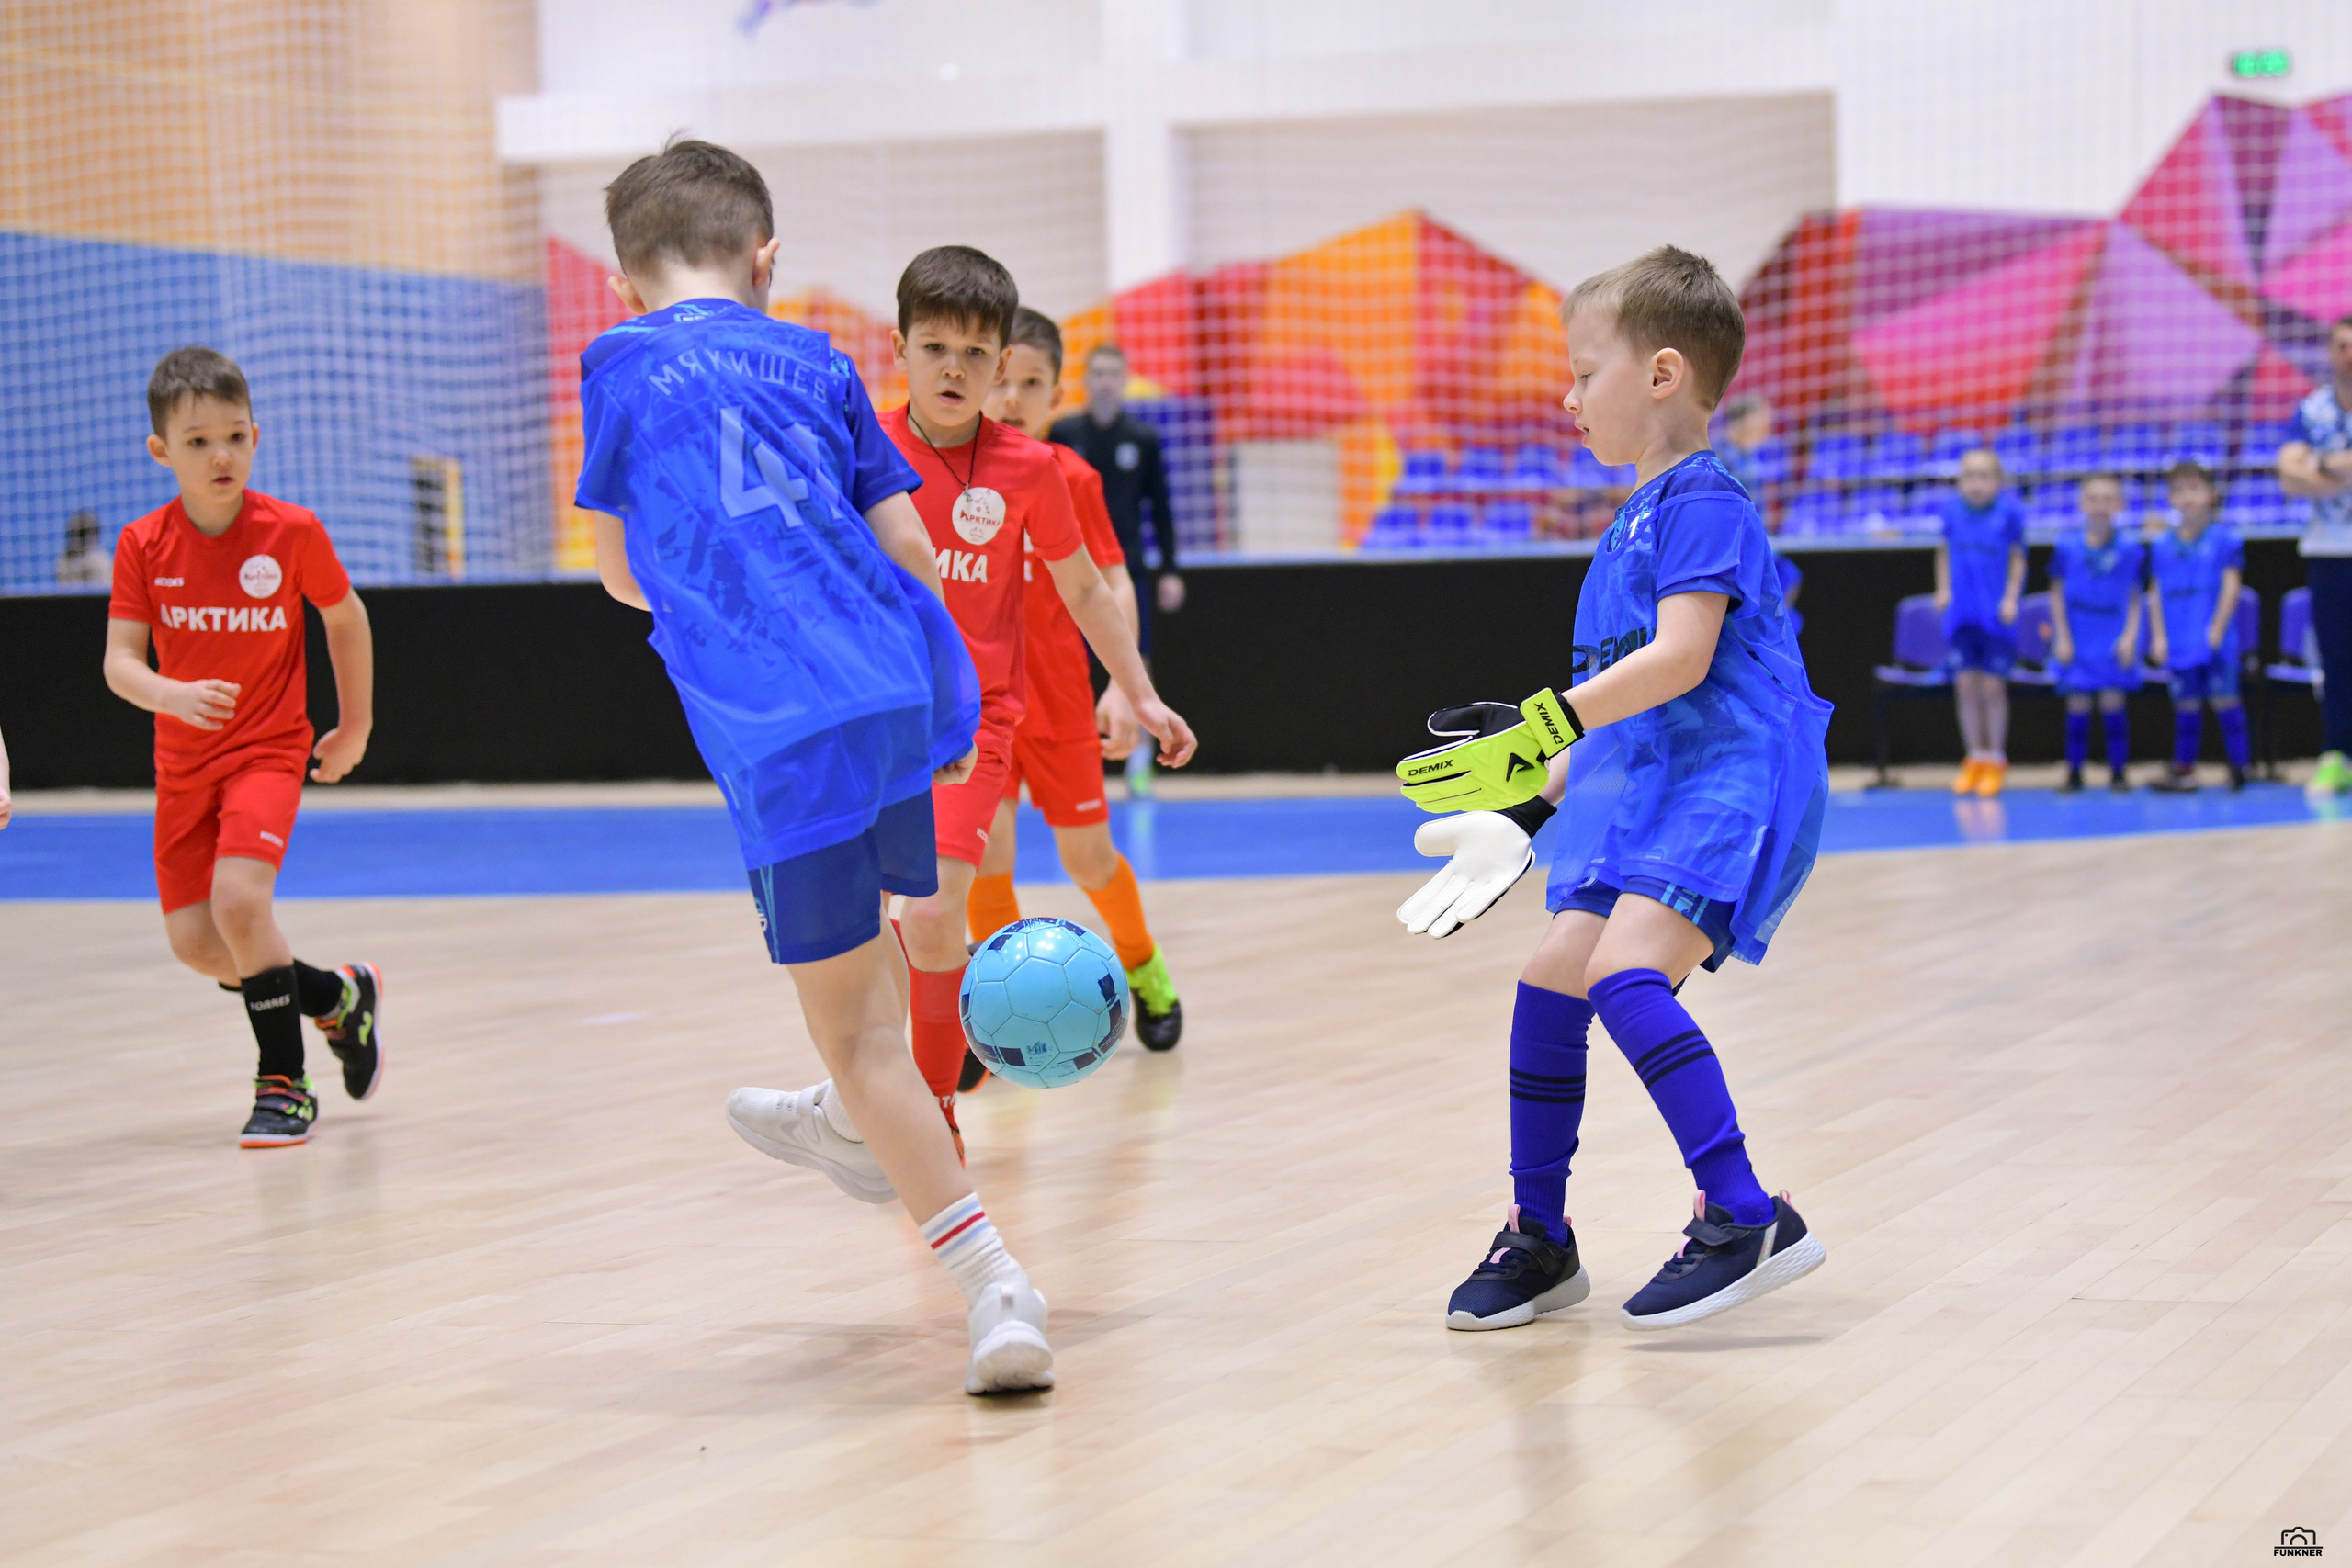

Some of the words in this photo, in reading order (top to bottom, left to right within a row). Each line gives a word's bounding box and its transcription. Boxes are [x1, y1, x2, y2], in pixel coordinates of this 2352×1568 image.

[649, 348, 827, 404] МЯКИШЕВ
[933, 548, 989, 583] ИКА
[160, 604, 288, 633] АРКТИКА
[1534, 702, 1564, 745] DEMIX
[1408, 759, 1454, 776] DEMIX
